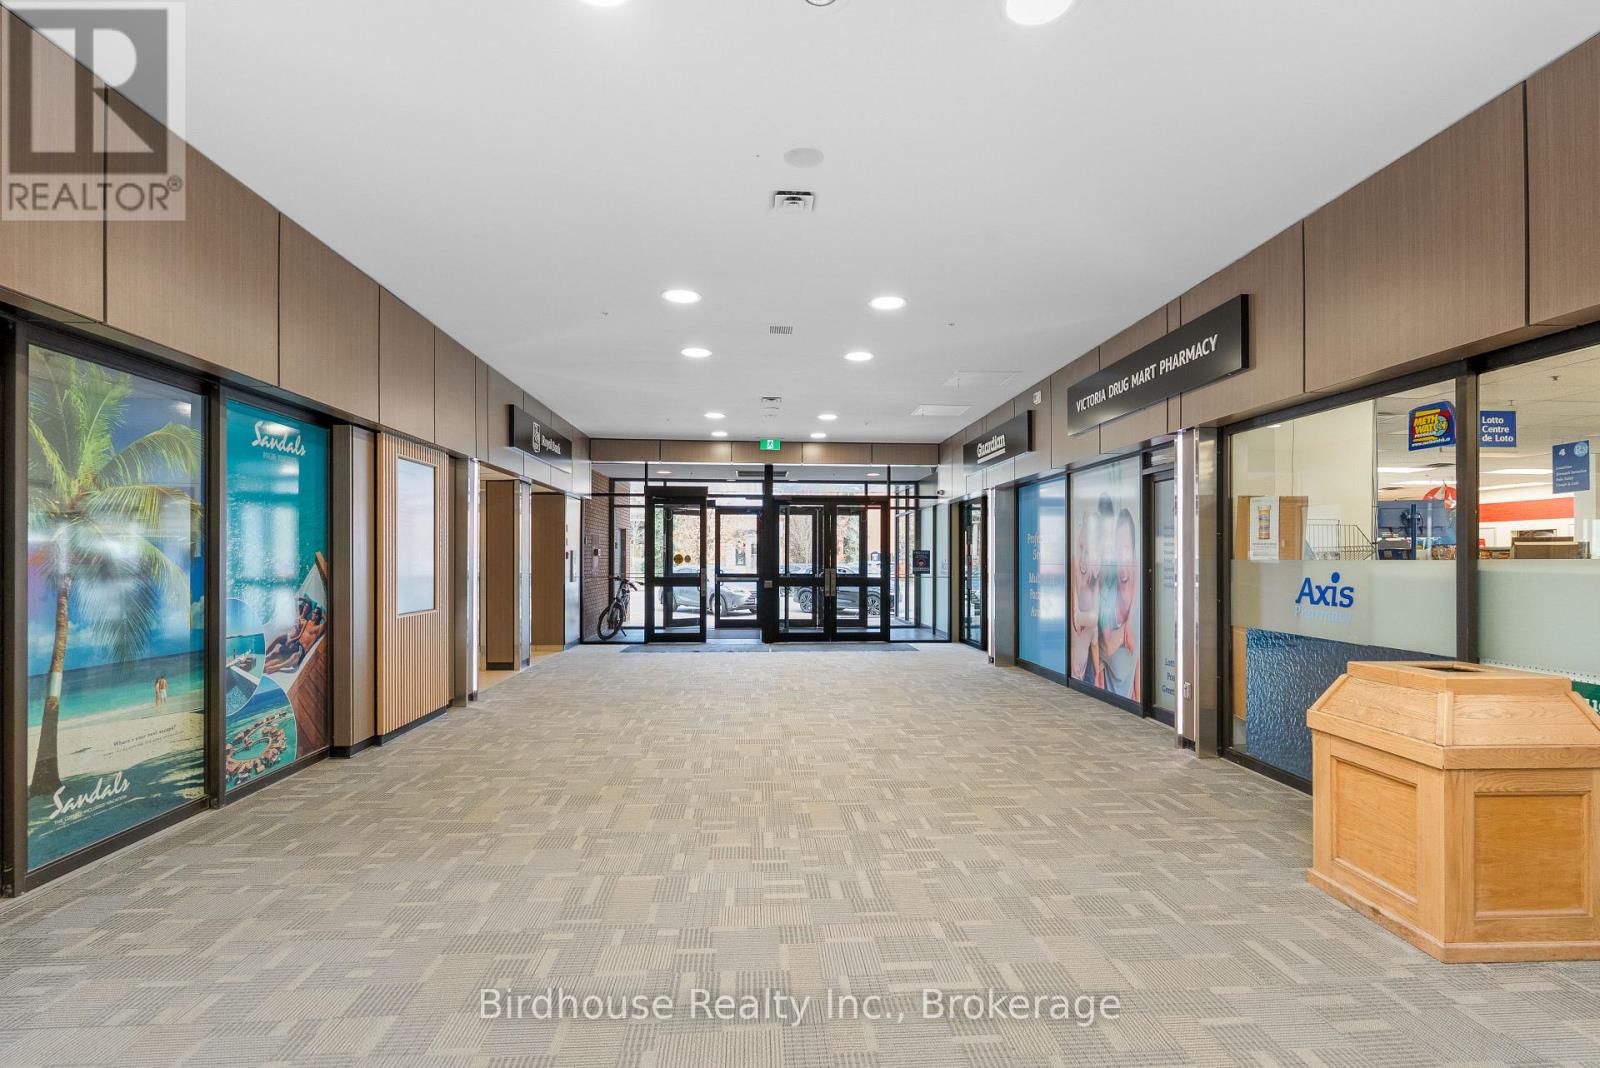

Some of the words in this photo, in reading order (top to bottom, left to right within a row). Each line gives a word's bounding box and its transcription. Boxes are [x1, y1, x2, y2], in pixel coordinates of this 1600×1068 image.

[1075, 389, 1107, 413] VICTORIA
[1108, 377, 1129, 399] DRUG
[1131, 363, 1157, 388] MART
[1159, 333, 1218, 376] PHARMACY
[1481, 416, 1504, 424] Lotto
[1481, 425, 1510, 433] Centre
[251, 420, 306, 457] Sandals
[976, 434, 1006, 458] Guardian
[1481, 434, 1493, 442] de
[1494, 434, 1514, 442] Loto
[1294, 571, 1355, 608] Axis
[49, 770, 131, 820] Sandals
